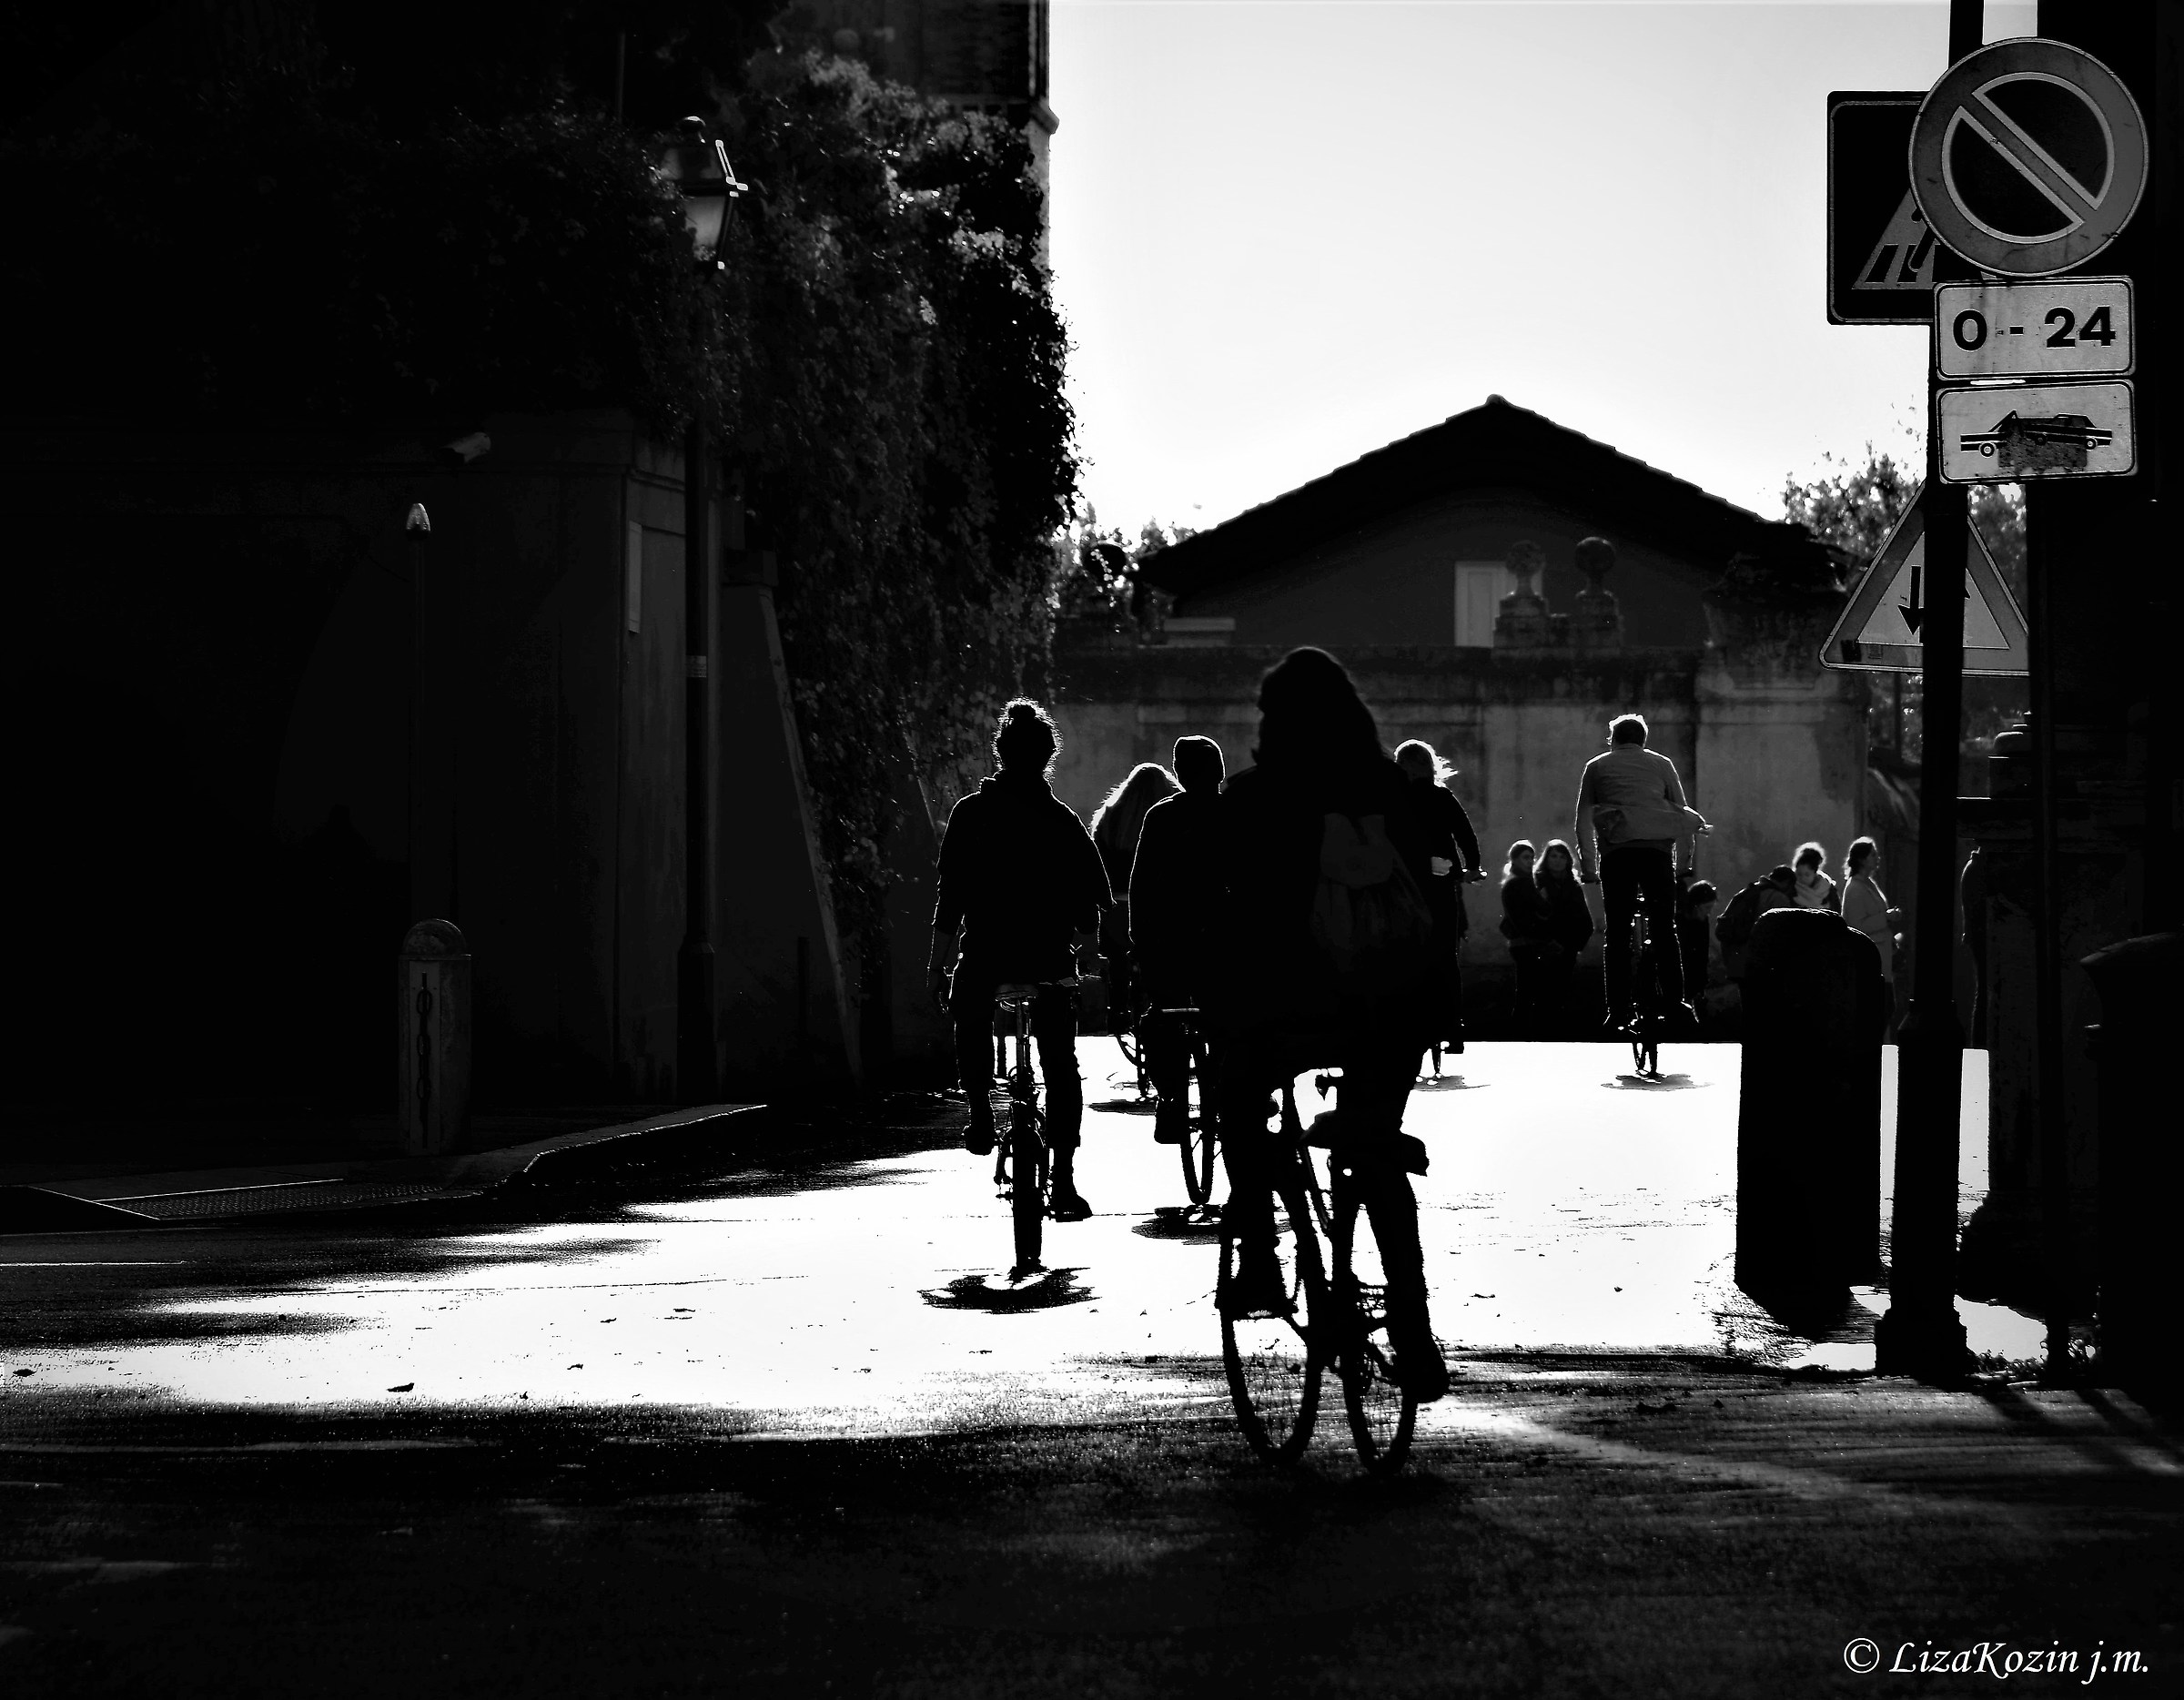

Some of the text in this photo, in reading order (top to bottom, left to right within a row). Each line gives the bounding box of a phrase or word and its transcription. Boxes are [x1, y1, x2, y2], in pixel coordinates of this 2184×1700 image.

[1953, 307, 2117, 351] 0 - 24
